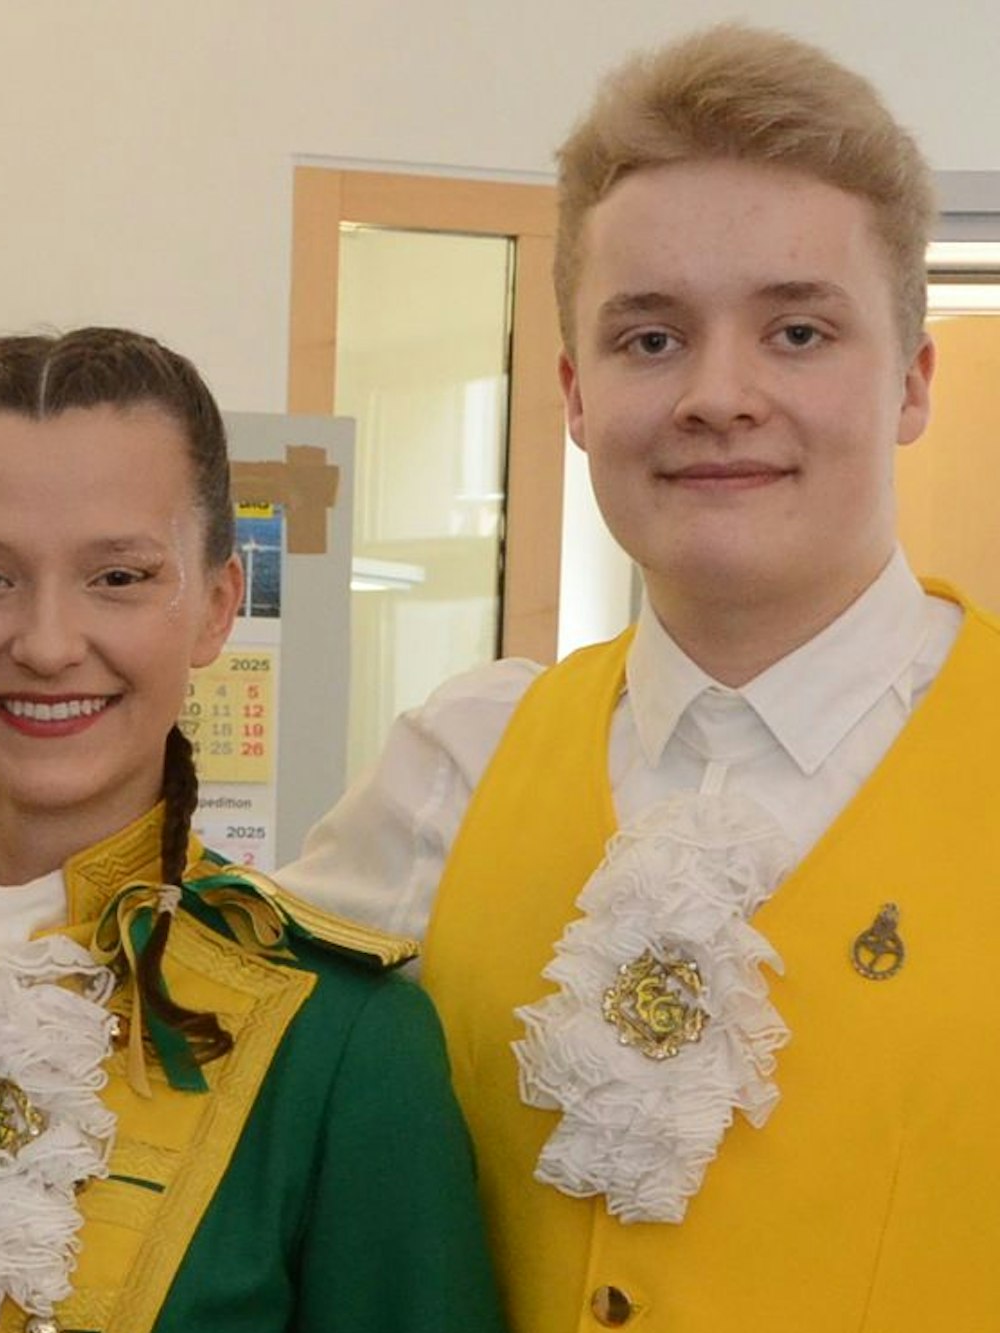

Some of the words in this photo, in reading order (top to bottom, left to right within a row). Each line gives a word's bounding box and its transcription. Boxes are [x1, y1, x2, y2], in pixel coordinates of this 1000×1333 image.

[230, 658, 271, 672] 2025
[247, 684, 259, 699] 5
[243, 703, 265, 719] 12
[243, 722, 265, 738] 19
[240, 741, 265, 757] 26
[226, 825, 267, 839] 2025
